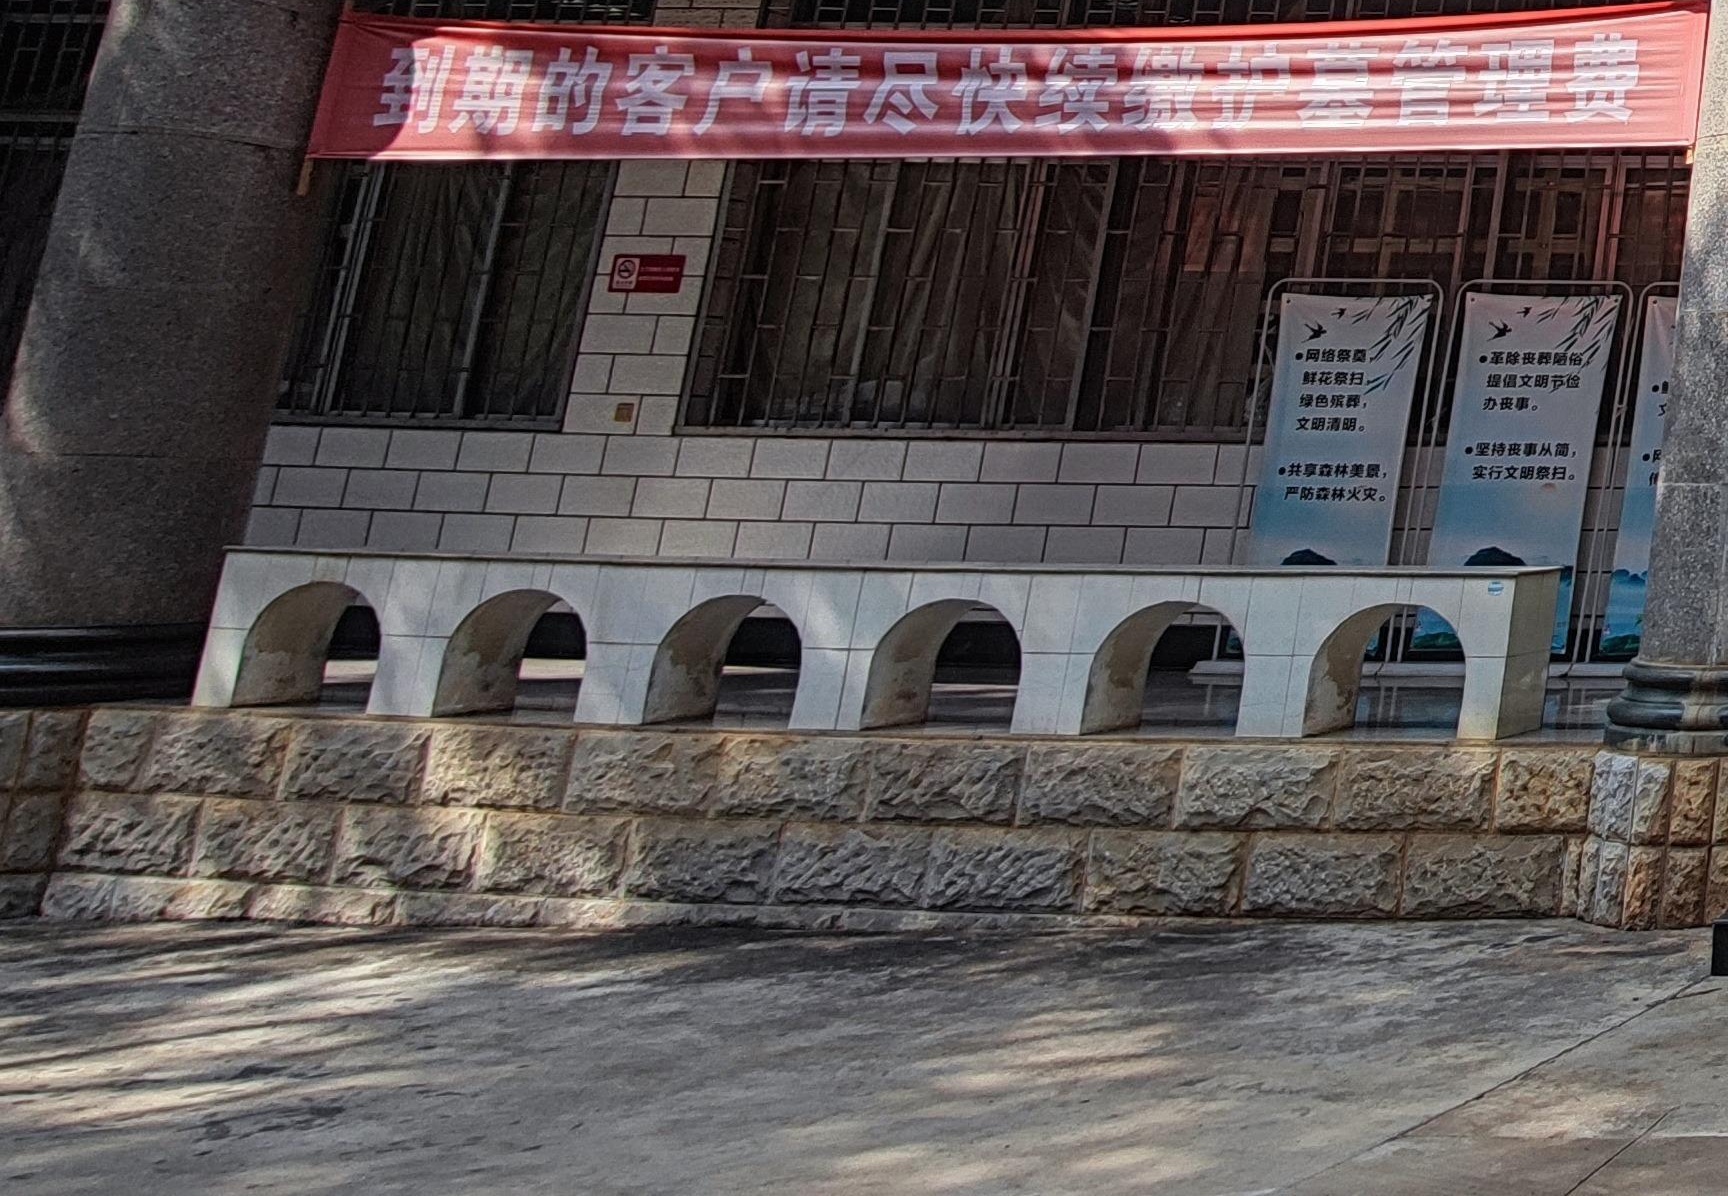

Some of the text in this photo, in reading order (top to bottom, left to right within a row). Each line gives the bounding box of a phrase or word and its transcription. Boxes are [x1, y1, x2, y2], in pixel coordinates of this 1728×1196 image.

[373, 33, 1640, 135] 到期的客户请尽快续缴护墓管理费
[1486, 373, 1581, 389] 提倡文明节俭
[1299, 393, 1367, 409] 绿色殡葬，
[1482, 396, 1539, 412] 办丧事。
[1295, 416, 1365, 432] 文明清明。
[1474, 442, 1578, 458] 坚持丧事从简，
[1286, 462, 1388, 480] 共享森林美景，
[1472, 465, 1576, 481] 实行文明祭扫。
[1284, 486, 1387, 502] 严防森林火灾。
